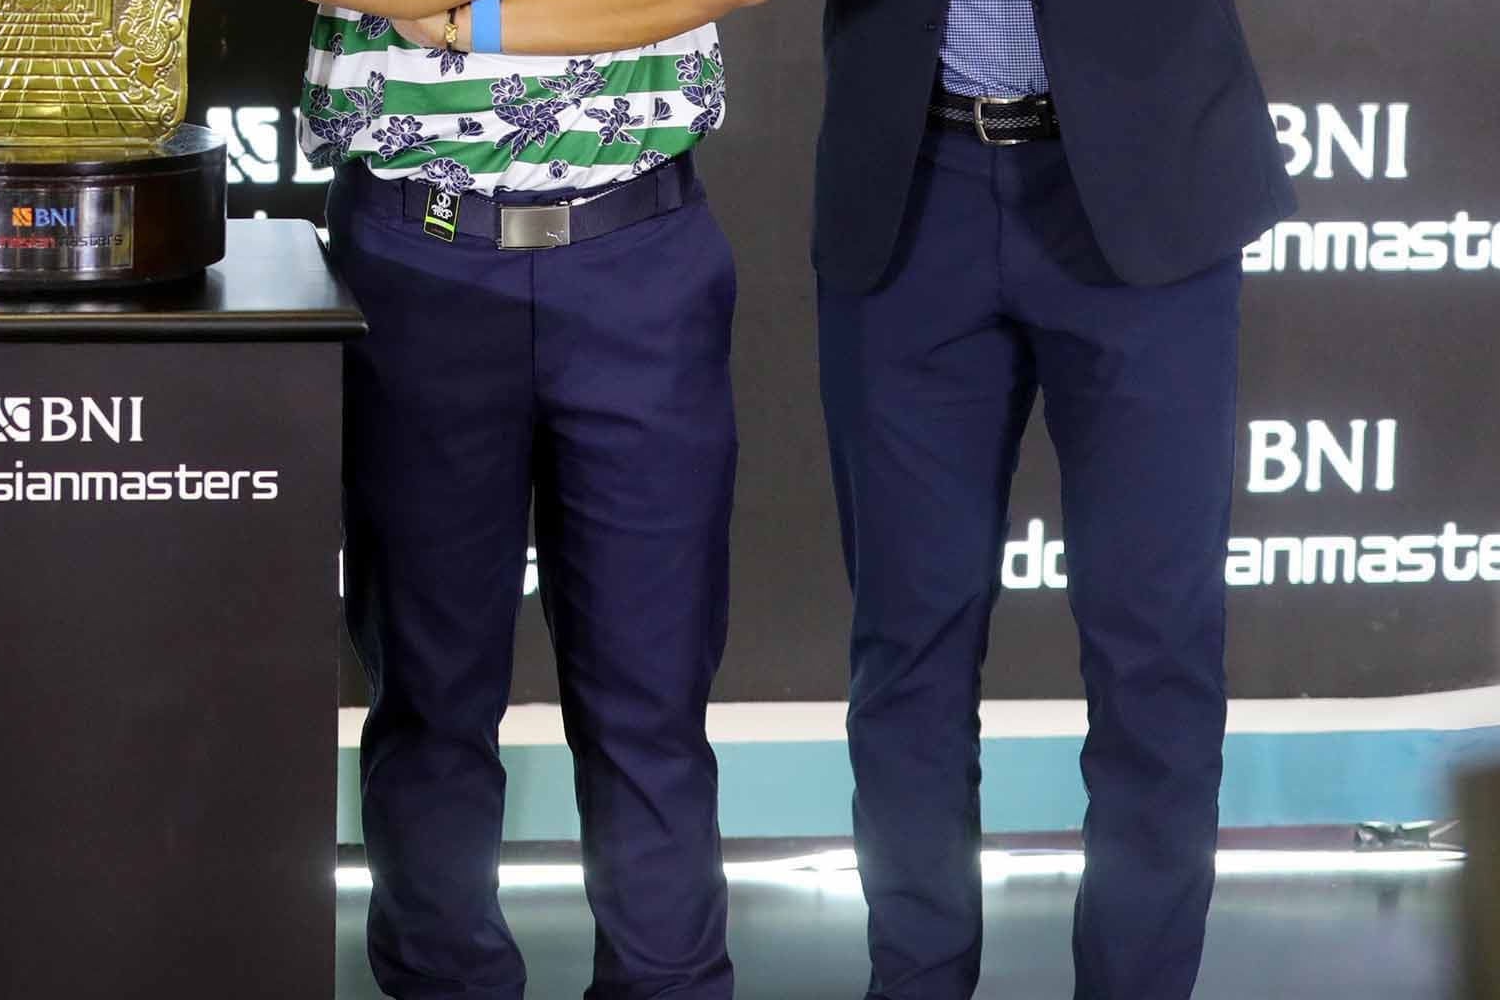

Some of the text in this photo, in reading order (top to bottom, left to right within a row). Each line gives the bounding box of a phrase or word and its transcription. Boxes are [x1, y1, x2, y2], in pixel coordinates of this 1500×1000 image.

[1266, 100, 1412, 182] BNI
[35, 207, 76, 228] BNI
[42, 398, 142, 442] BNI
[1248, 419, 1395, 492] BNI
